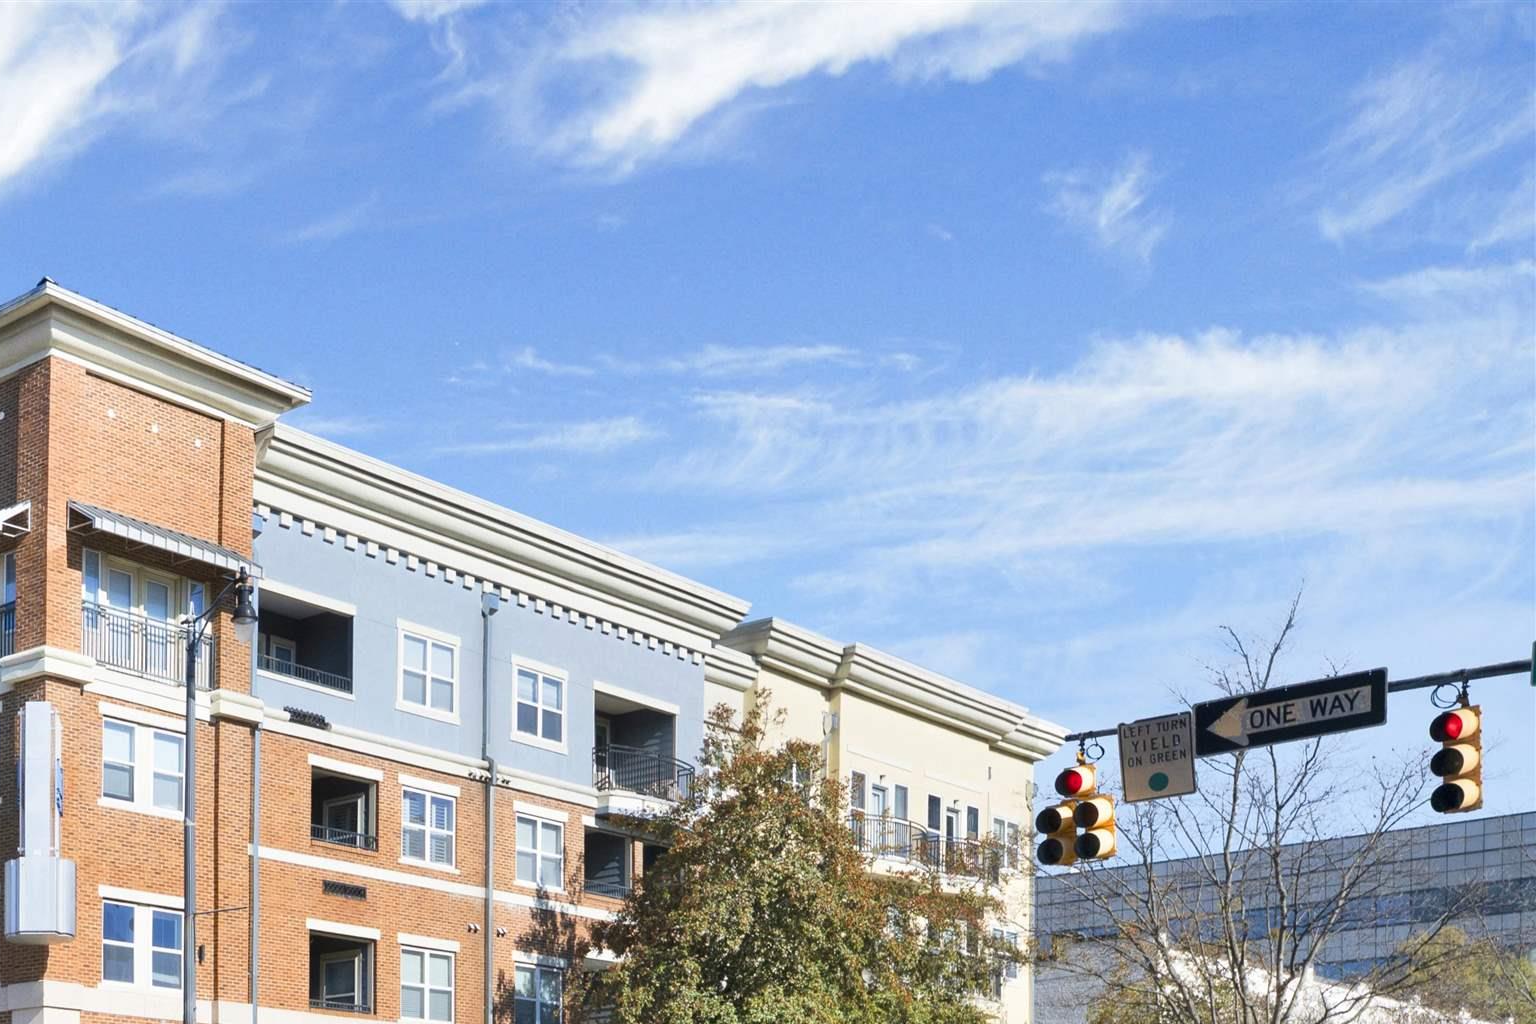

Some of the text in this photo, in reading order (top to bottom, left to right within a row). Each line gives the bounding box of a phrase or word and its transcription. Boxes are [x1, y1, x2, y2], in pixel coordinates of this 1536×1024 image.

[1249, 690, 1361, 729] ONE WAY
[1123, 718, 1187, 739] LEFT TURN
[1131, 734, 1181, 753] YIELD
[1128, 749, 1187, 768] ON GREEN
